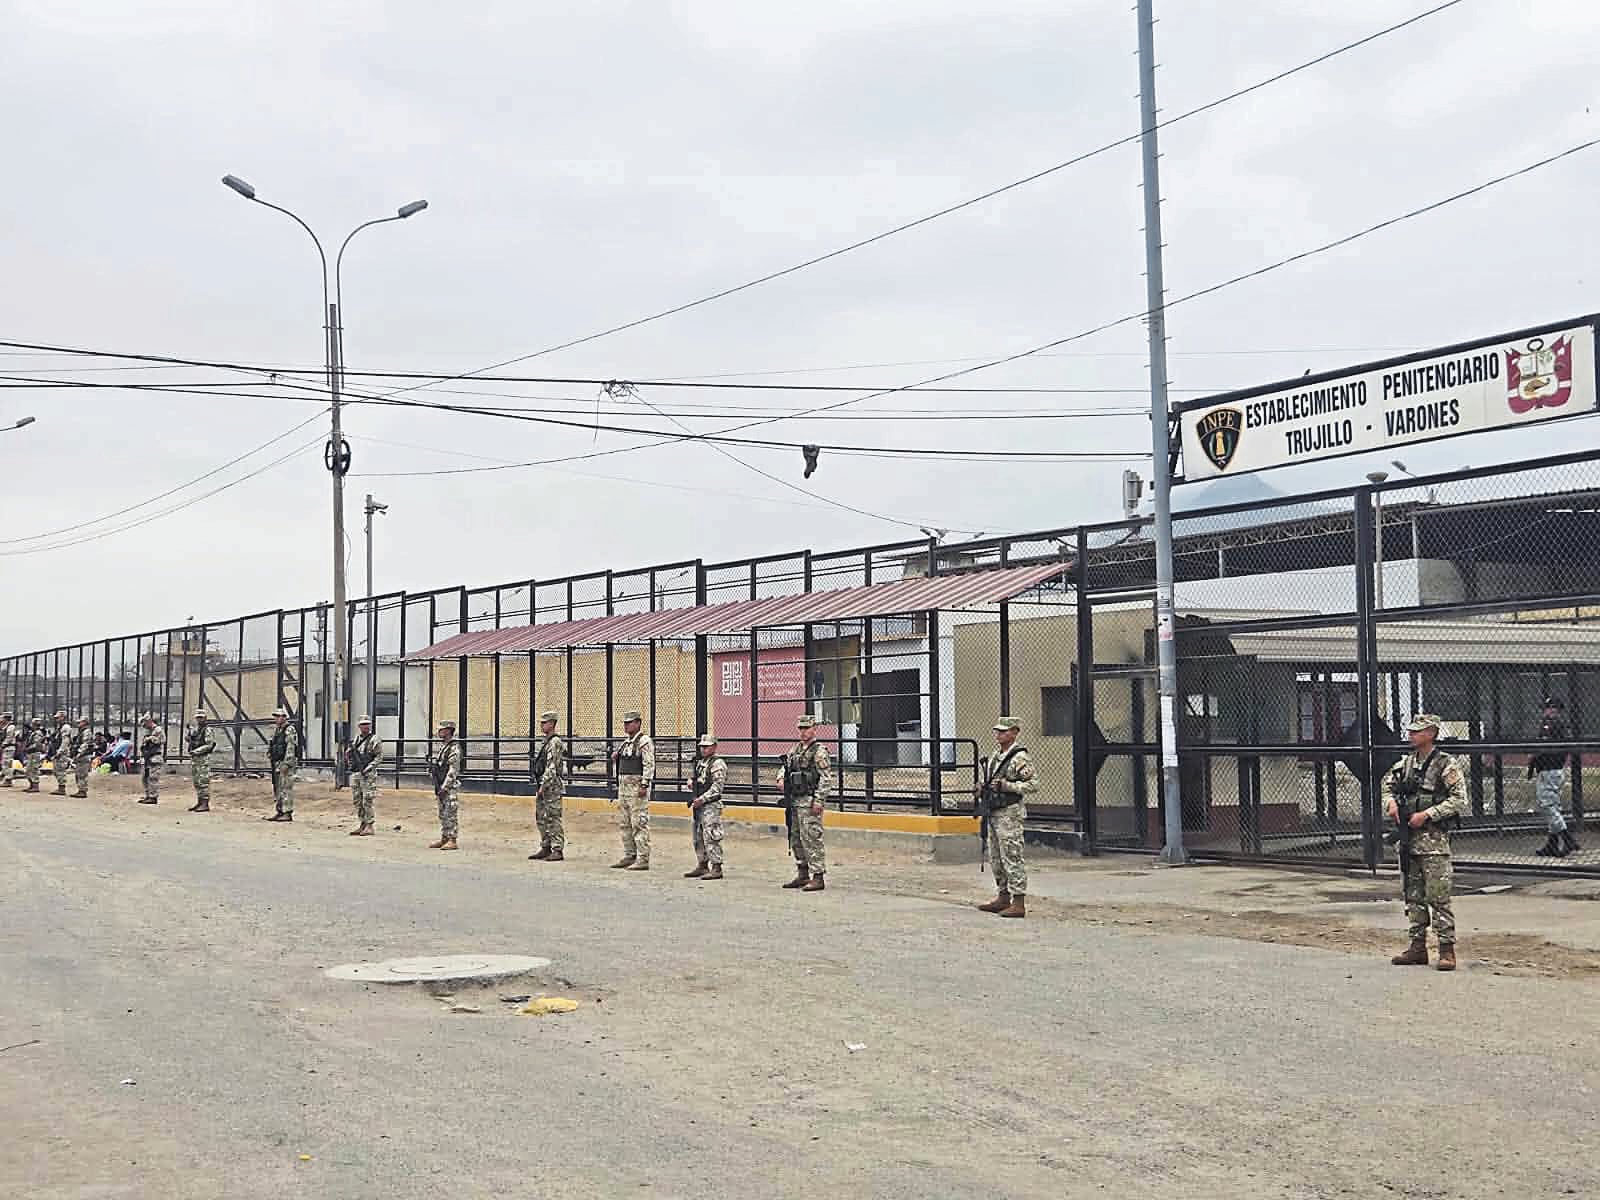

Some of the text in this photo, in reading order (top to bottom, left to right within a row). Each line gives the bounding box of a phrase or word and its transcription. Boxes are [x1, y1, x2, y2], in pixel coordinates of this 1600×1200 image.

[1246, 353, 1499, 428] ESTABLECIMIENTO PENITENCIARIO
[1203, 411, 1235, 433] INPE
[1285, 420, 1352, 455] TRUJILLO
[1386, 399, 1459, 436] VARONES
